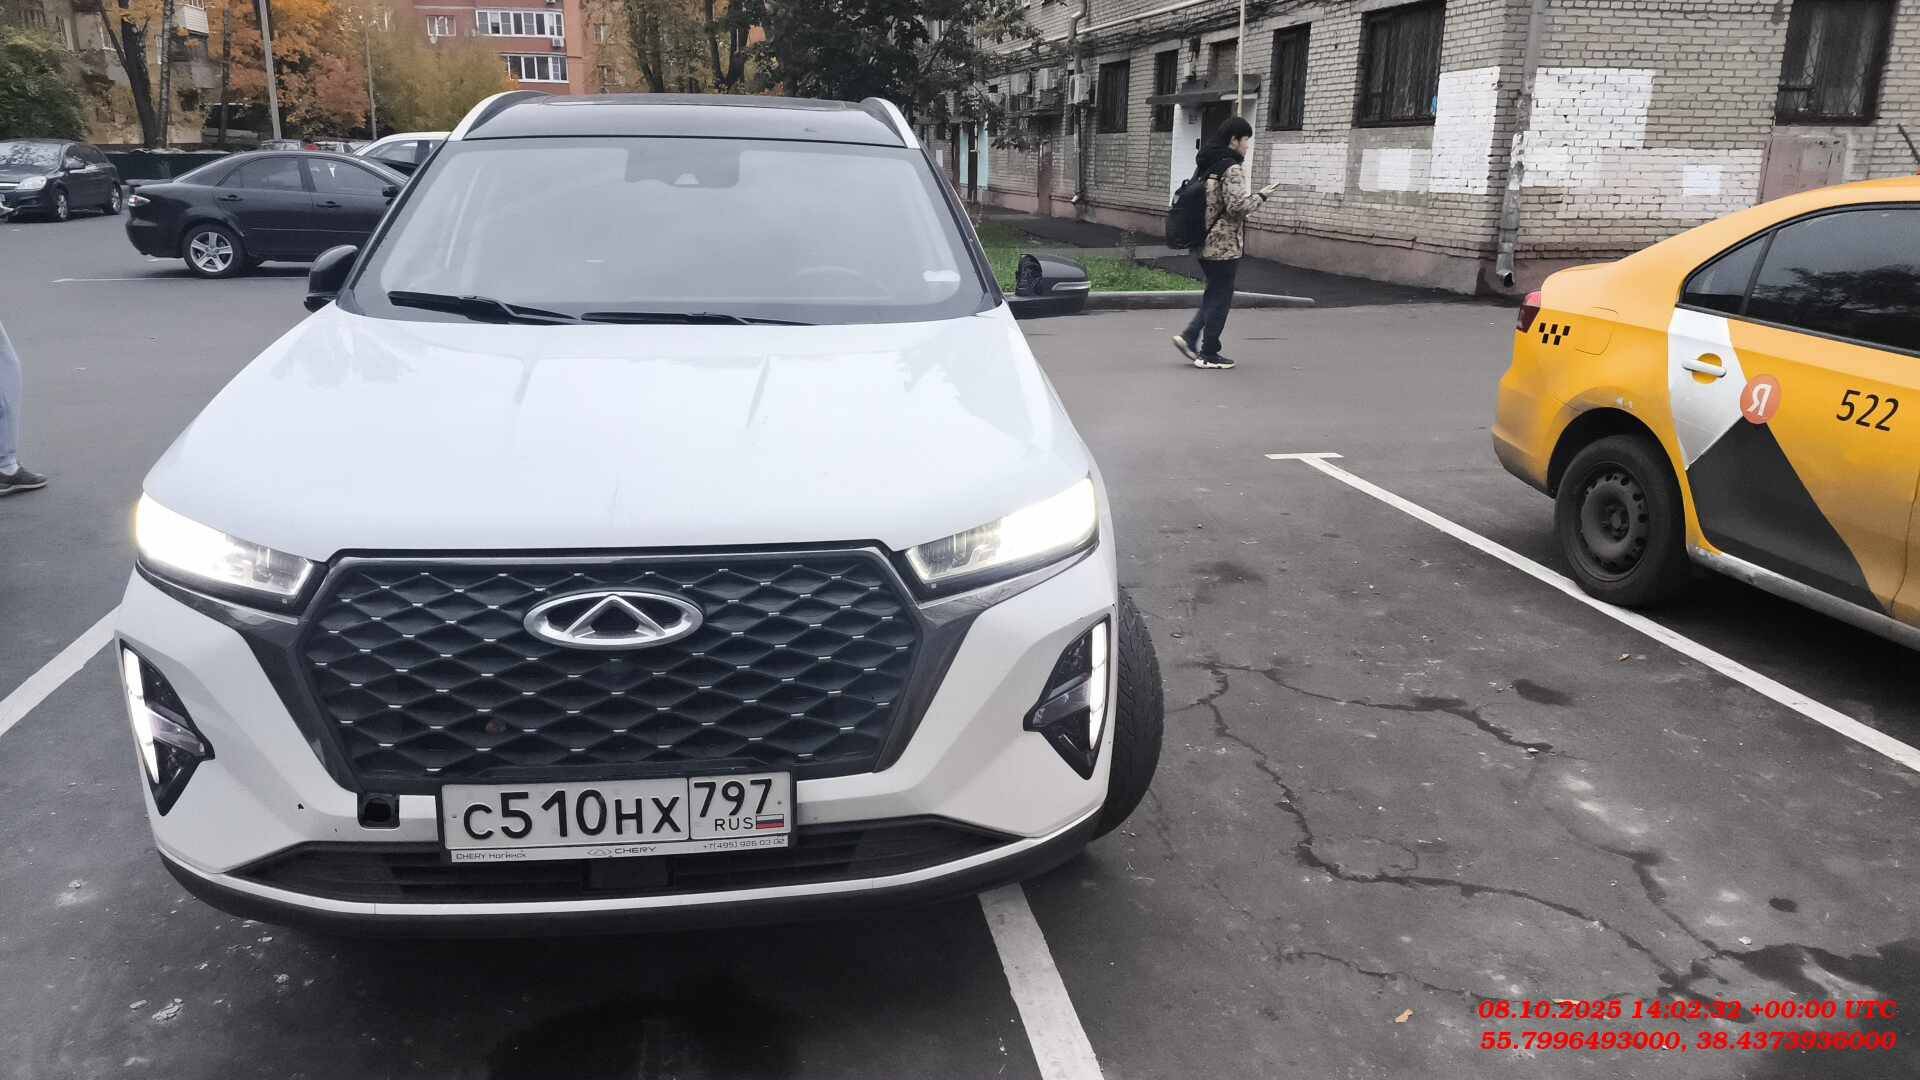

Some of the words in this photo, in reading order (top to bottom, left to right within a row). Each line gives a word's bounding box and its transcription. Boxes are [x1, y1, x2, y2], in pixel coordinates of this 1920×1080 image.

[1835, 389, 1899, 432] 522
[693, 778, 773, 818] 797
[714, 817, 754, 831] RUS
[614, 846, 657, 855] CHERY
